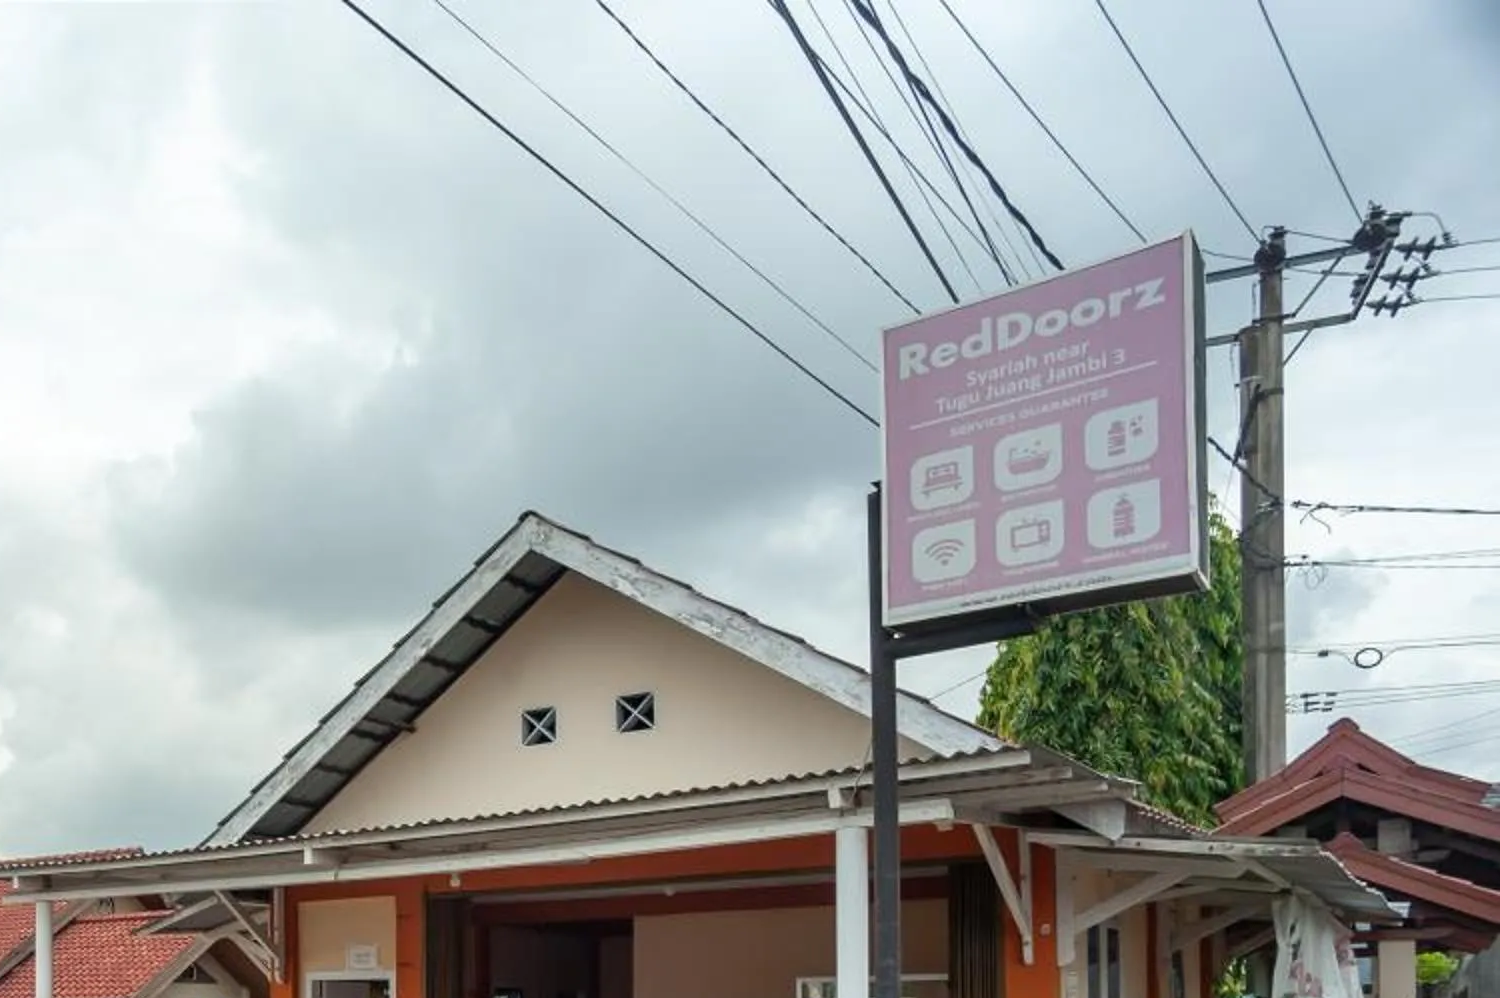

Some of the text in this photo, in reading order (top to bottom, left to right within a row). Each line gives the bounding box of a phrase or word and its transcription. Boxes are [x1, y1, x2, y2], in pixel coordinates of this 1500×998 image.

[899, 276, 1166, 380] RedDoorz
[936, 348, 1126, 415] Tugu Juang Jambi 3
[966, 340, 1090, 387] Syariah near
